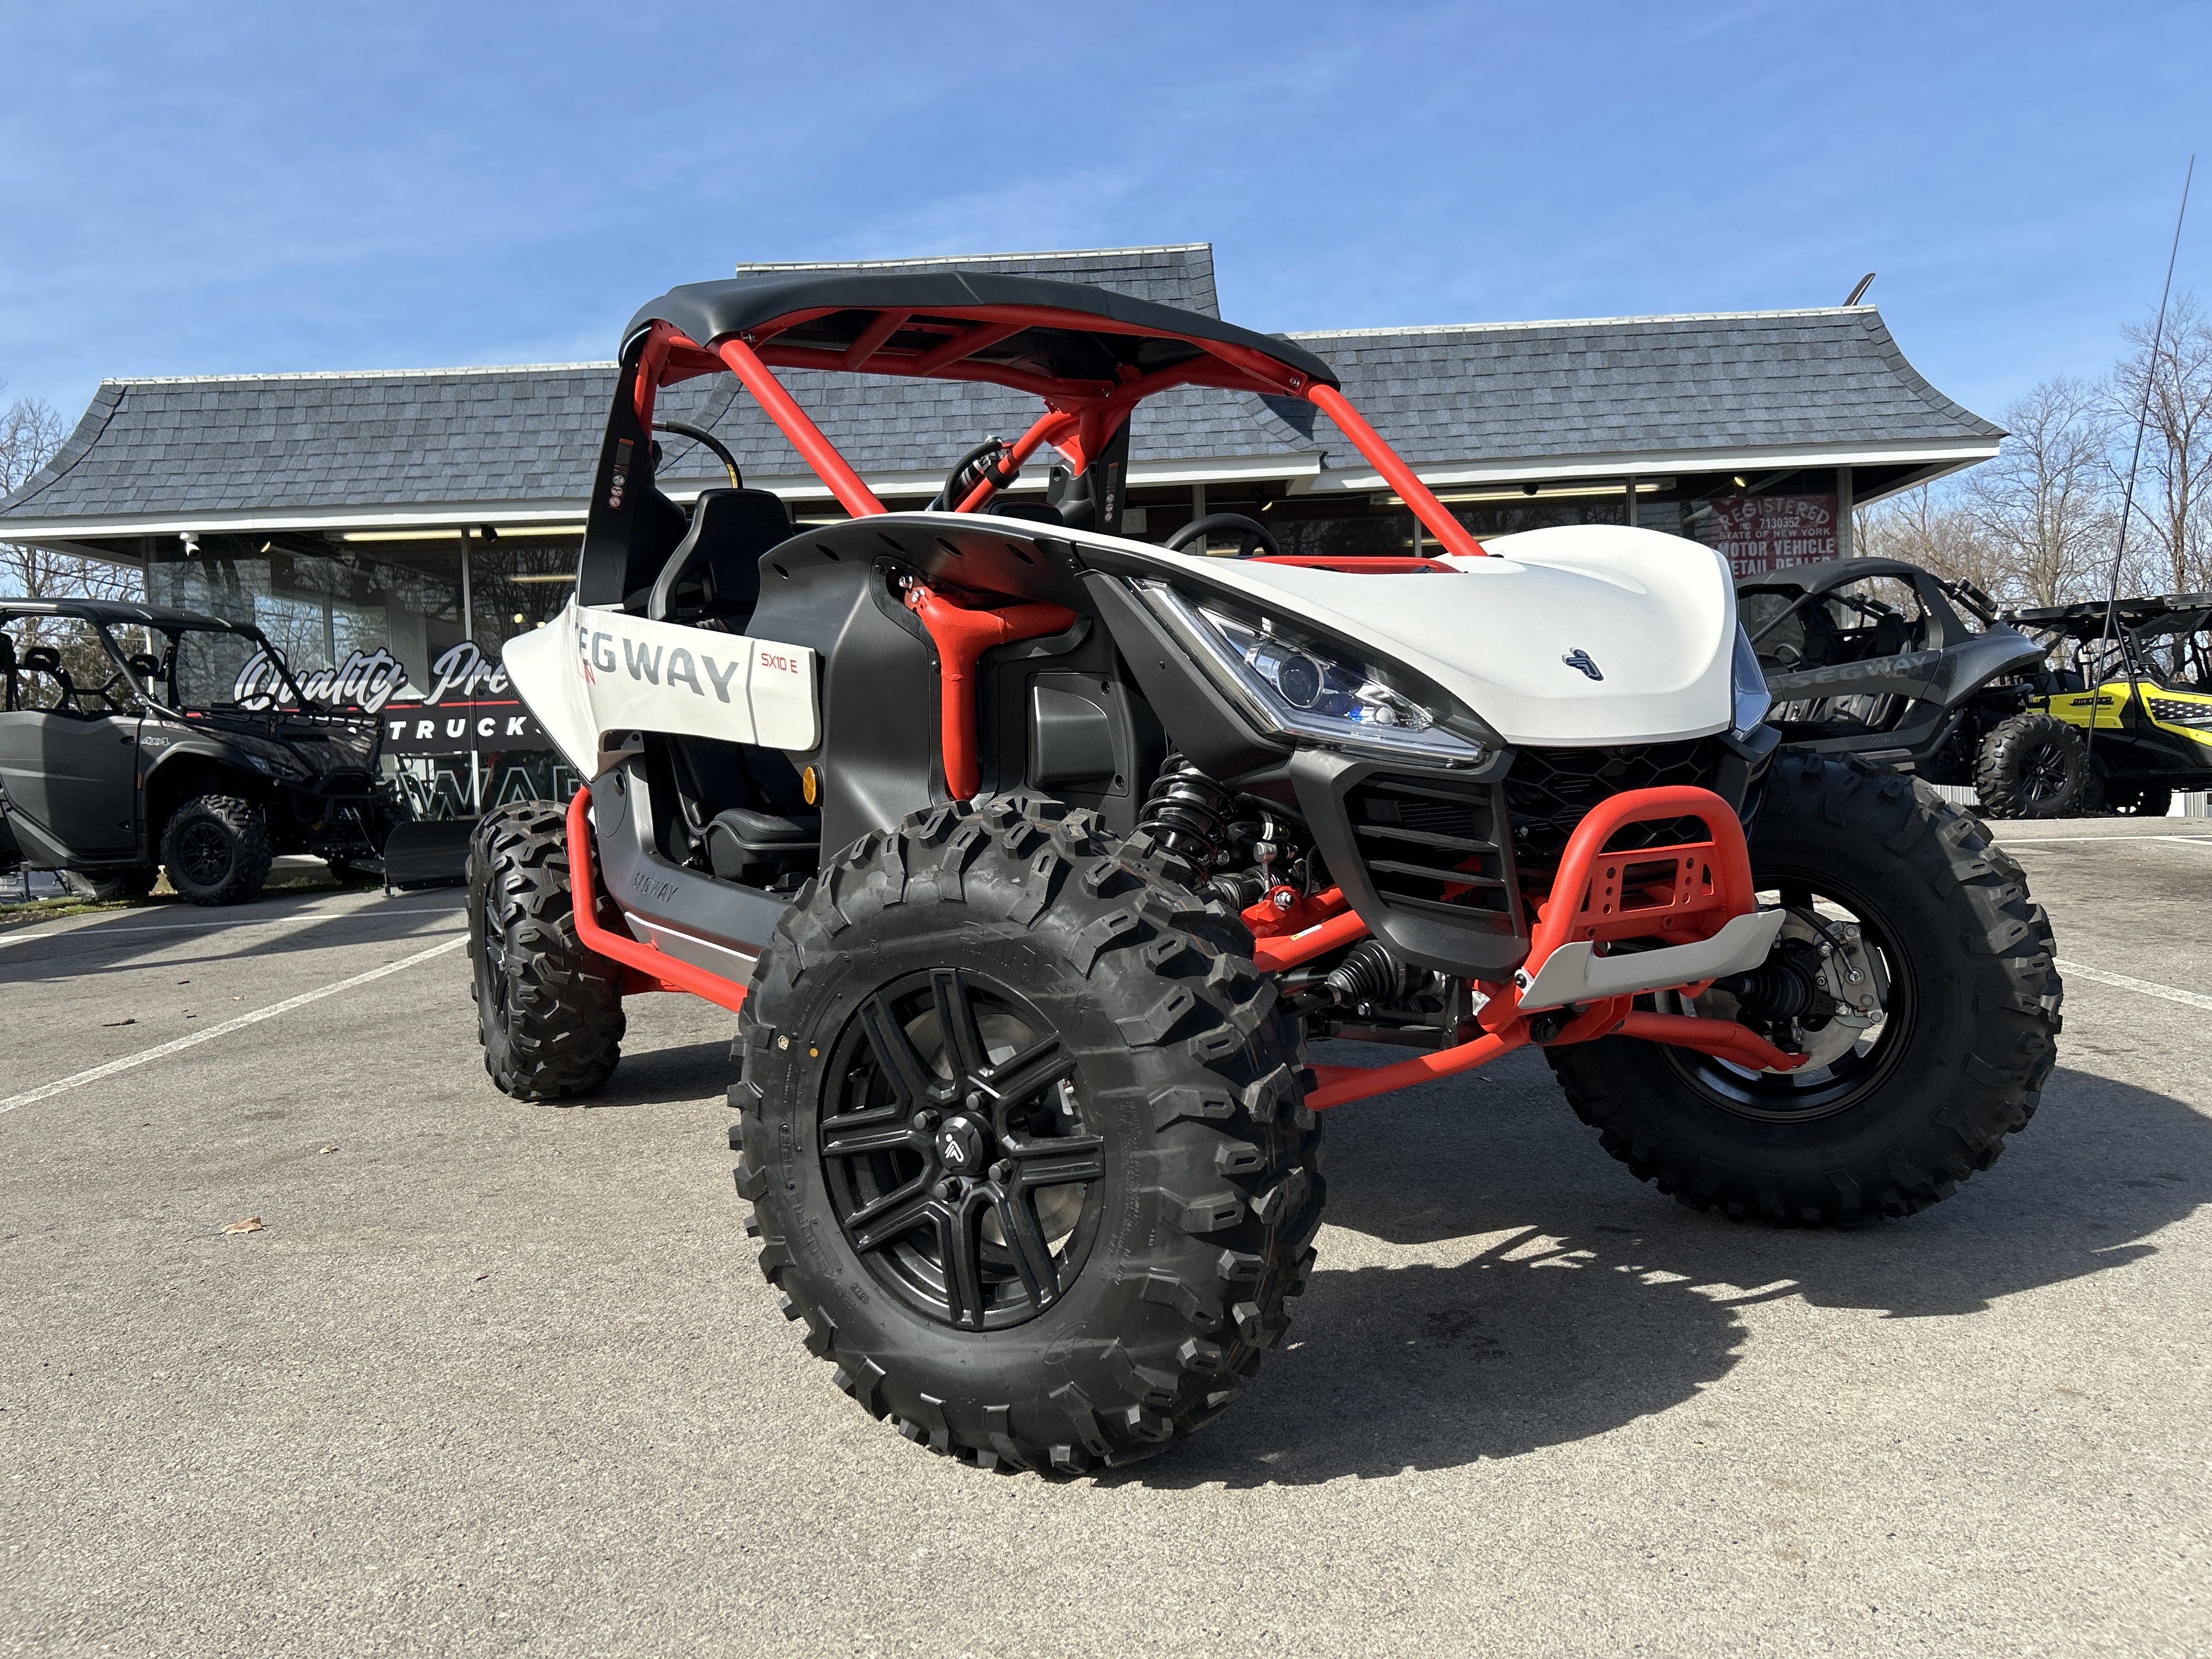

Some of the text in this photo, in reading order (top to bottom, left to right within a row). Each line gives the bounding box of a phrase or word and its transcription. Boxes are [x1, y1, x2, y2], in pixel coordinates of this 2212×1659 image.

[1718, 498, 1830, 530] REGISTERED
[1759, 516, 1800, 529] 7130352
[1719, 527, 1831, 540] STATE OF NEW YORK
[1717, 538, 1835, 557] MOTOR VEHICLE
[1731, 559, 1767, 575] ETAIL
[575, 622, 739, 704] EGWAY
[761, 653, 799, 674] SX10 E
[1790, 656, 1927, 689] SEGWAY
[234, 646, 407, 714] Quality
[390, 716, 542, 741] TRUCK
